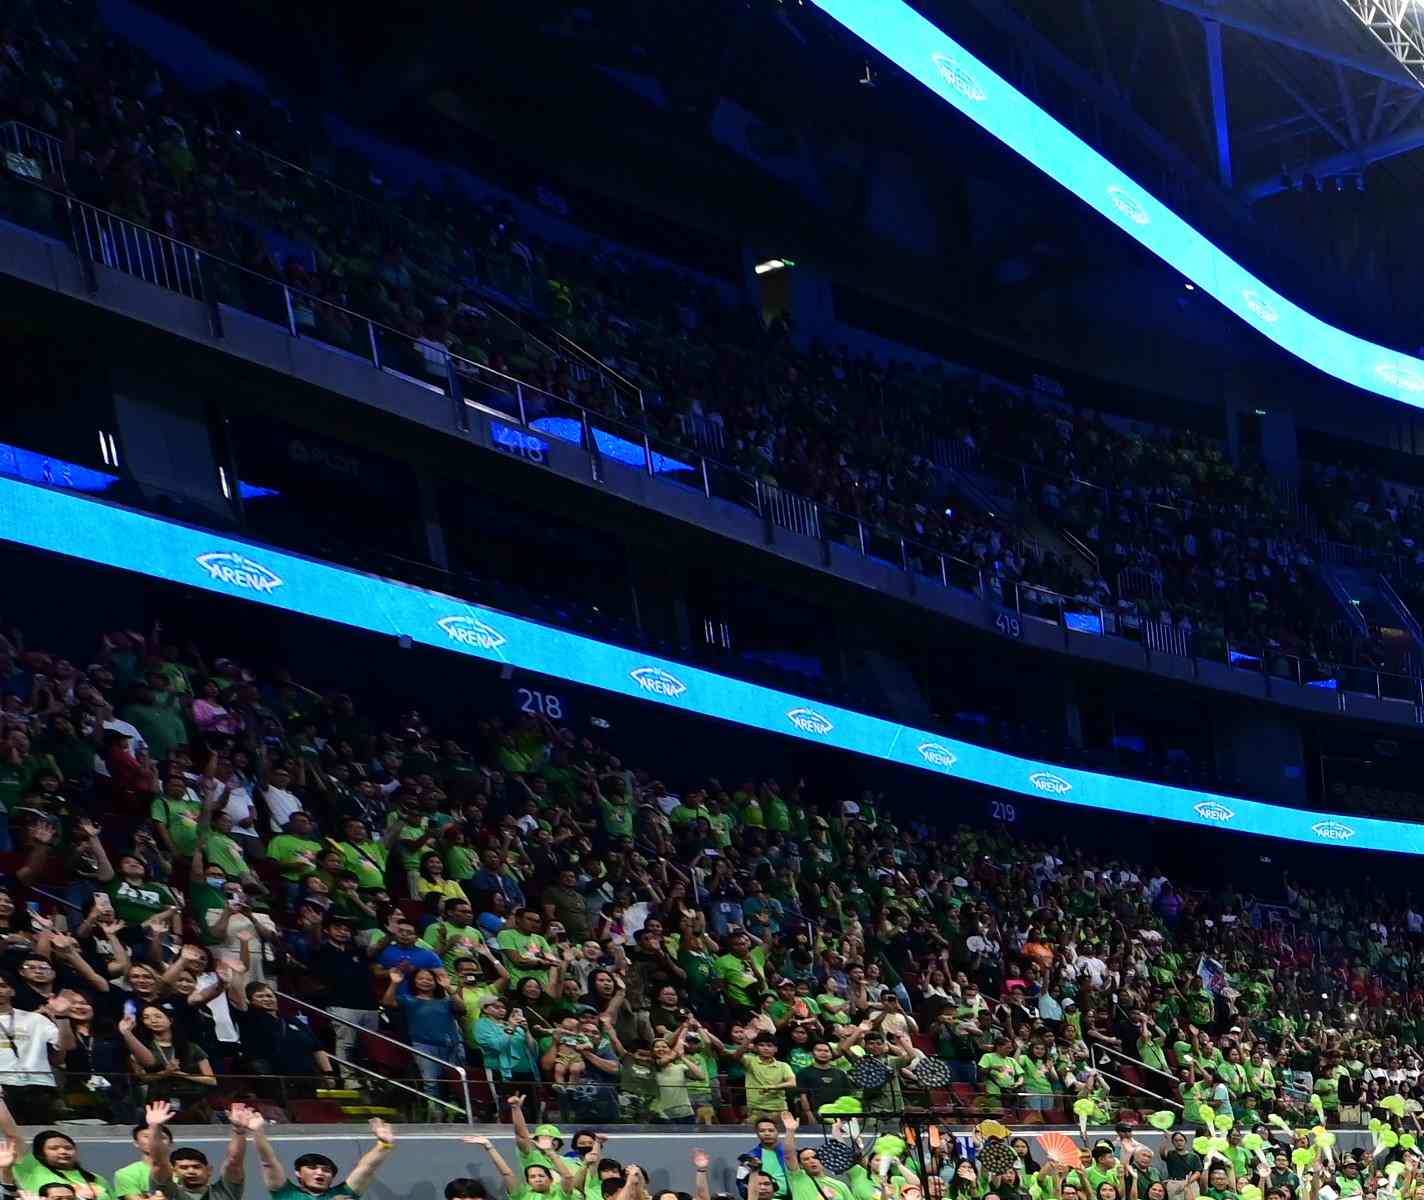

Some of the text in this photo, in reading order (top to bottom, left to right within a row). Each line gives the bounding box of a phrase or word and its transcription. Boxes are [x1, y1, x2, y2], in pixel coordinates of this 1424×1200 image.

[211, 566, 275, 593] ARENA
[996, 613, 1019, 638] 419
[449, 626, 502, 649] ARENA
[640, 677, 681, 698] ARENA
[519, 688, 564, 720] 218
[796, 717, 829, 736] ARENA
[991, 800, 1015, 823] 219
[1318, 828, 1348, 841] ARENA
